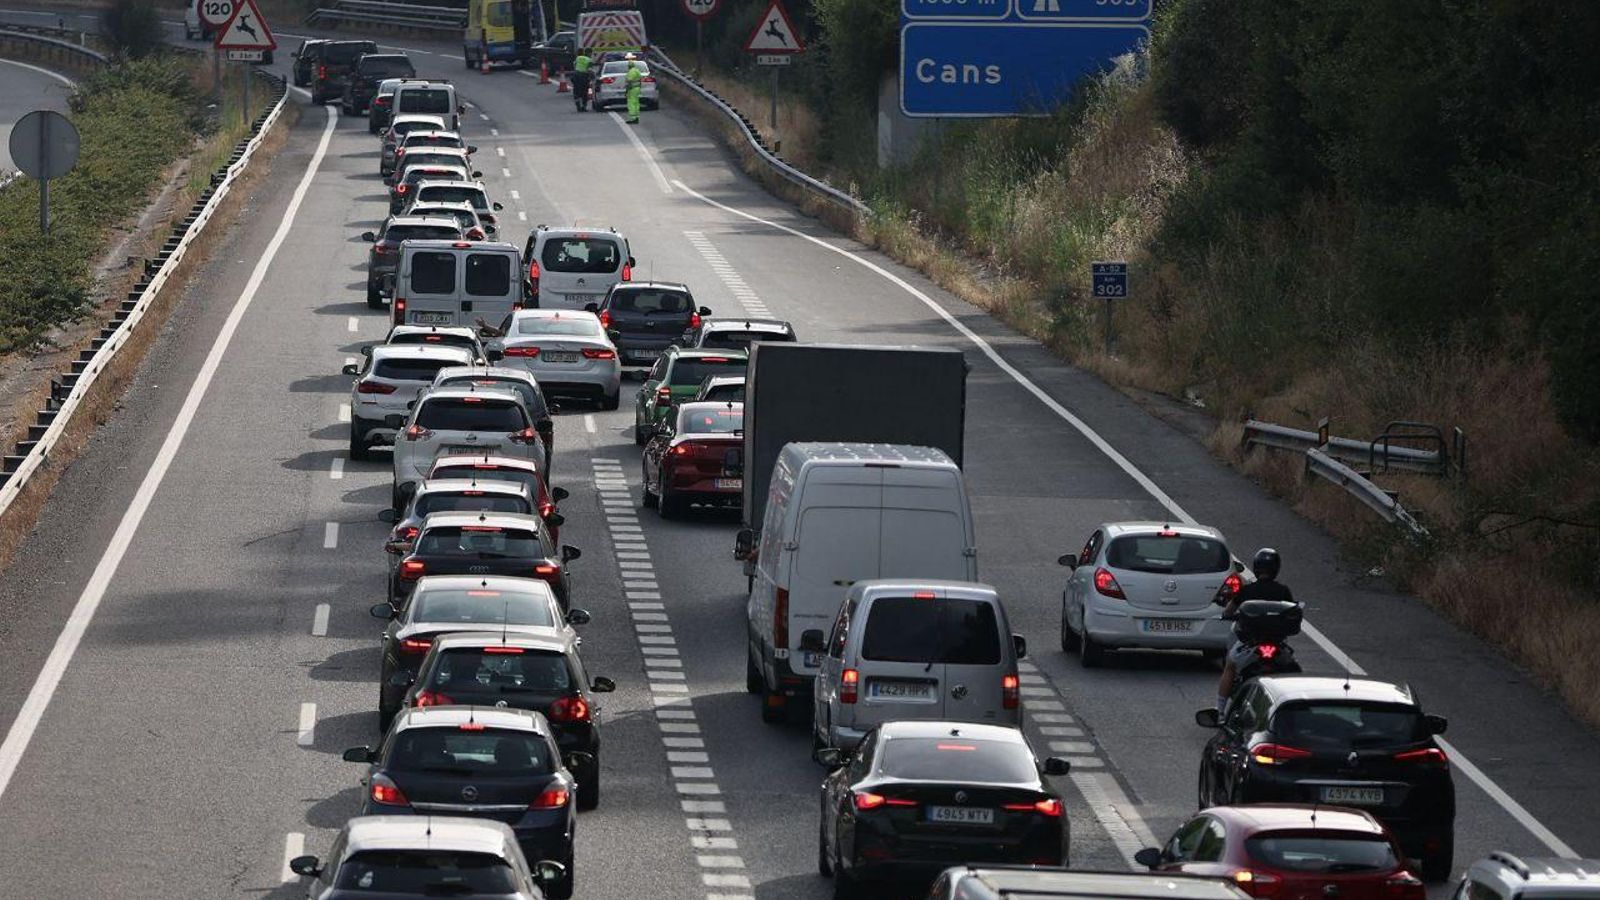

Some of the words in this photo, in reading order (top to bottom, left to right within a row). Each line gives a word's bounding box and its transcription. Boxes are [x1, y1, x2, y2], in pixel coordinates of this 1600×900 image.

[204, 2, 231, 15] 120
[916, 58, 1001, 84] Cans
[1097, 284, 1123, 296] 302
[936, 807, 965, 820] 4945
